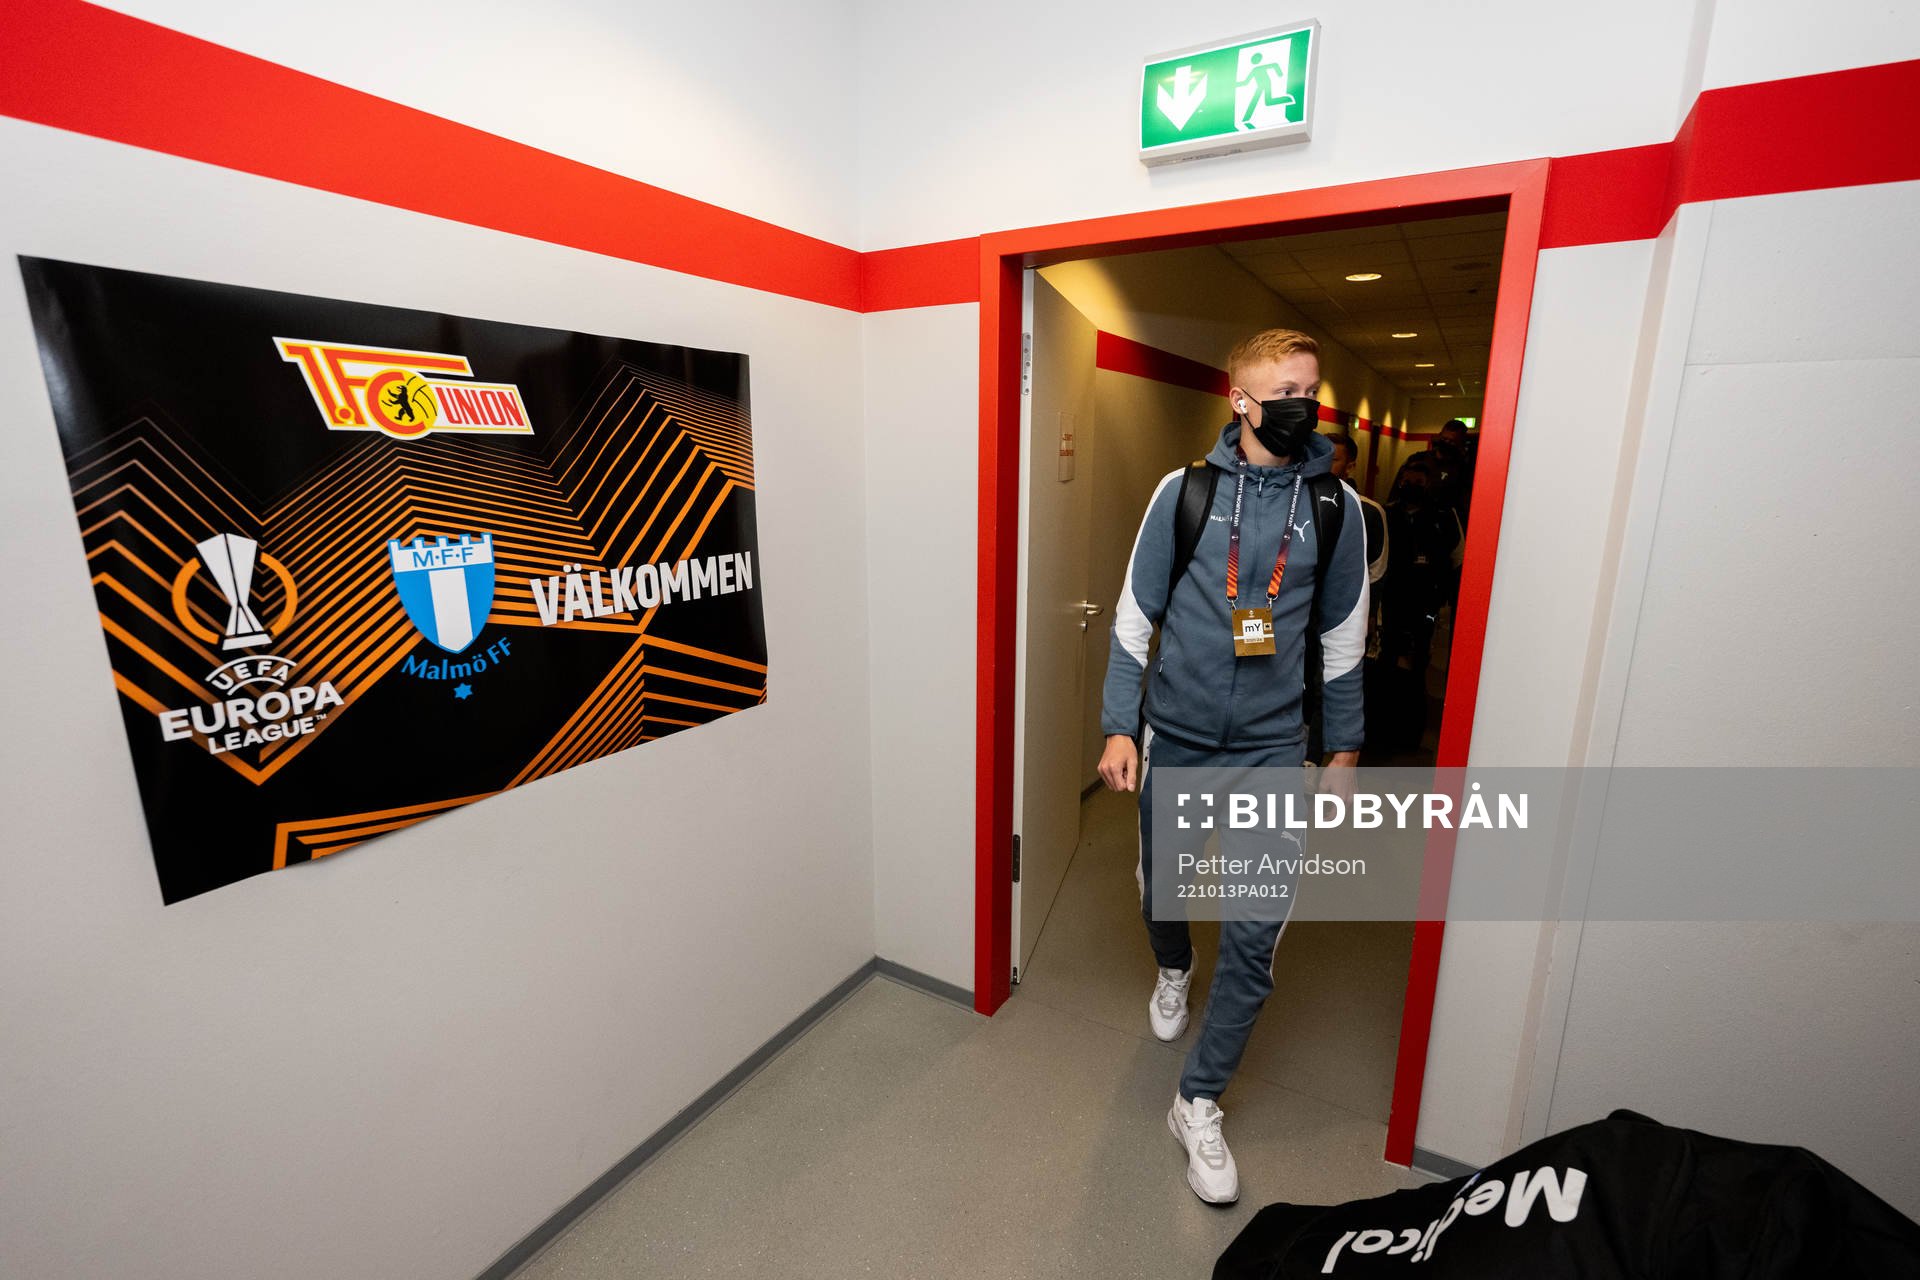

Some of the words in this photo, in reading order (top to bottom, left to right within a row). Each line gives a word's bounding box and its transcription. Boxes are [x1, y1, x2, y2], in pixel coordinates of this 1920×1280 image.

[435, 386, 525, 427] UNION
[1237, 474, 1245, 494] LEAGUE
[1290, 494, 1298, 514] EUROPA
[1294, 474, 1302, 495] LEAGUE
[530, 551, 754, 627] VÄLKOMMEN
[1245, 623, 1261, 632] mY
[211, 661, 289, 690] UEFA
[401, 653, 488, 680] Malmö
[487, 637, 512, 665] FF
[159, 680, 345, 742] EUROPA
[208, 716, 316, 755] LEAGUE
[1321, 1166, 1588, 1274] Medical
